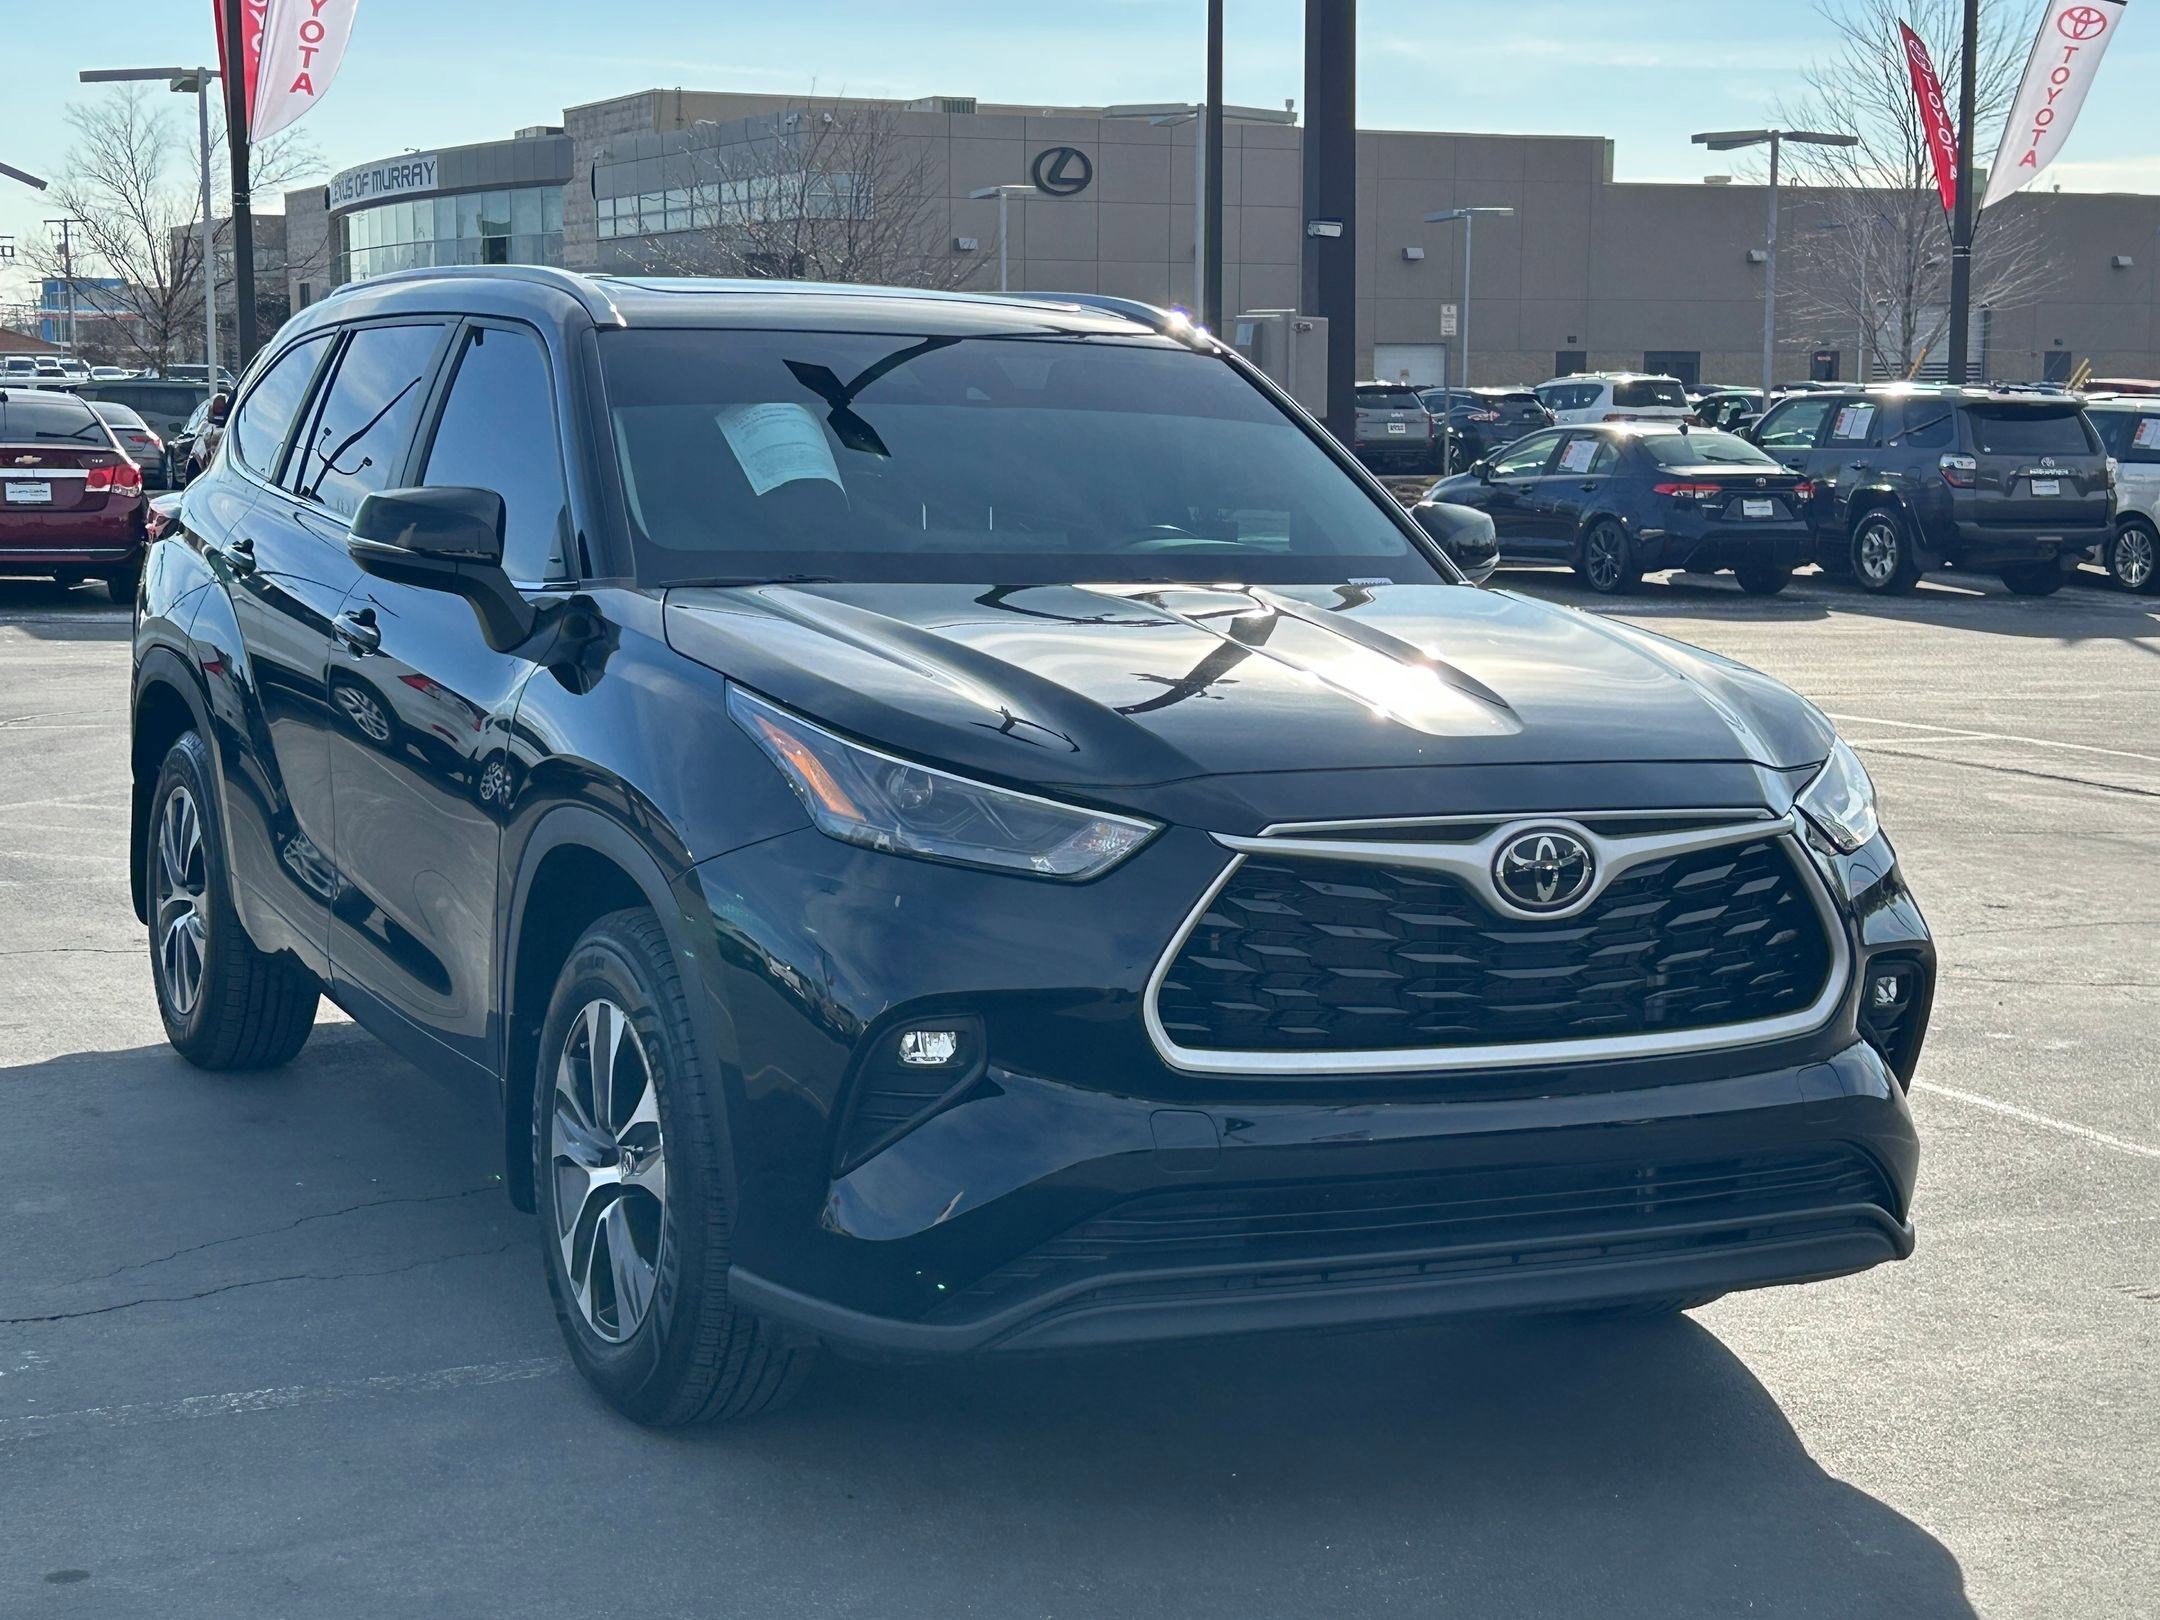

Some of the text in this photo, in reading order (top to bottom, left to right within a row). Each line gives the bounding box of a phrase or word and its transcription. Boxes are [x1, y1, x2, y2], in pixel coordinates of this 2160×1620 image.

[2019, 45, 2079, 168] TOYOTA
[355, 172, 369, 198] OF
[372, 160, 436, 193] MURRAY
